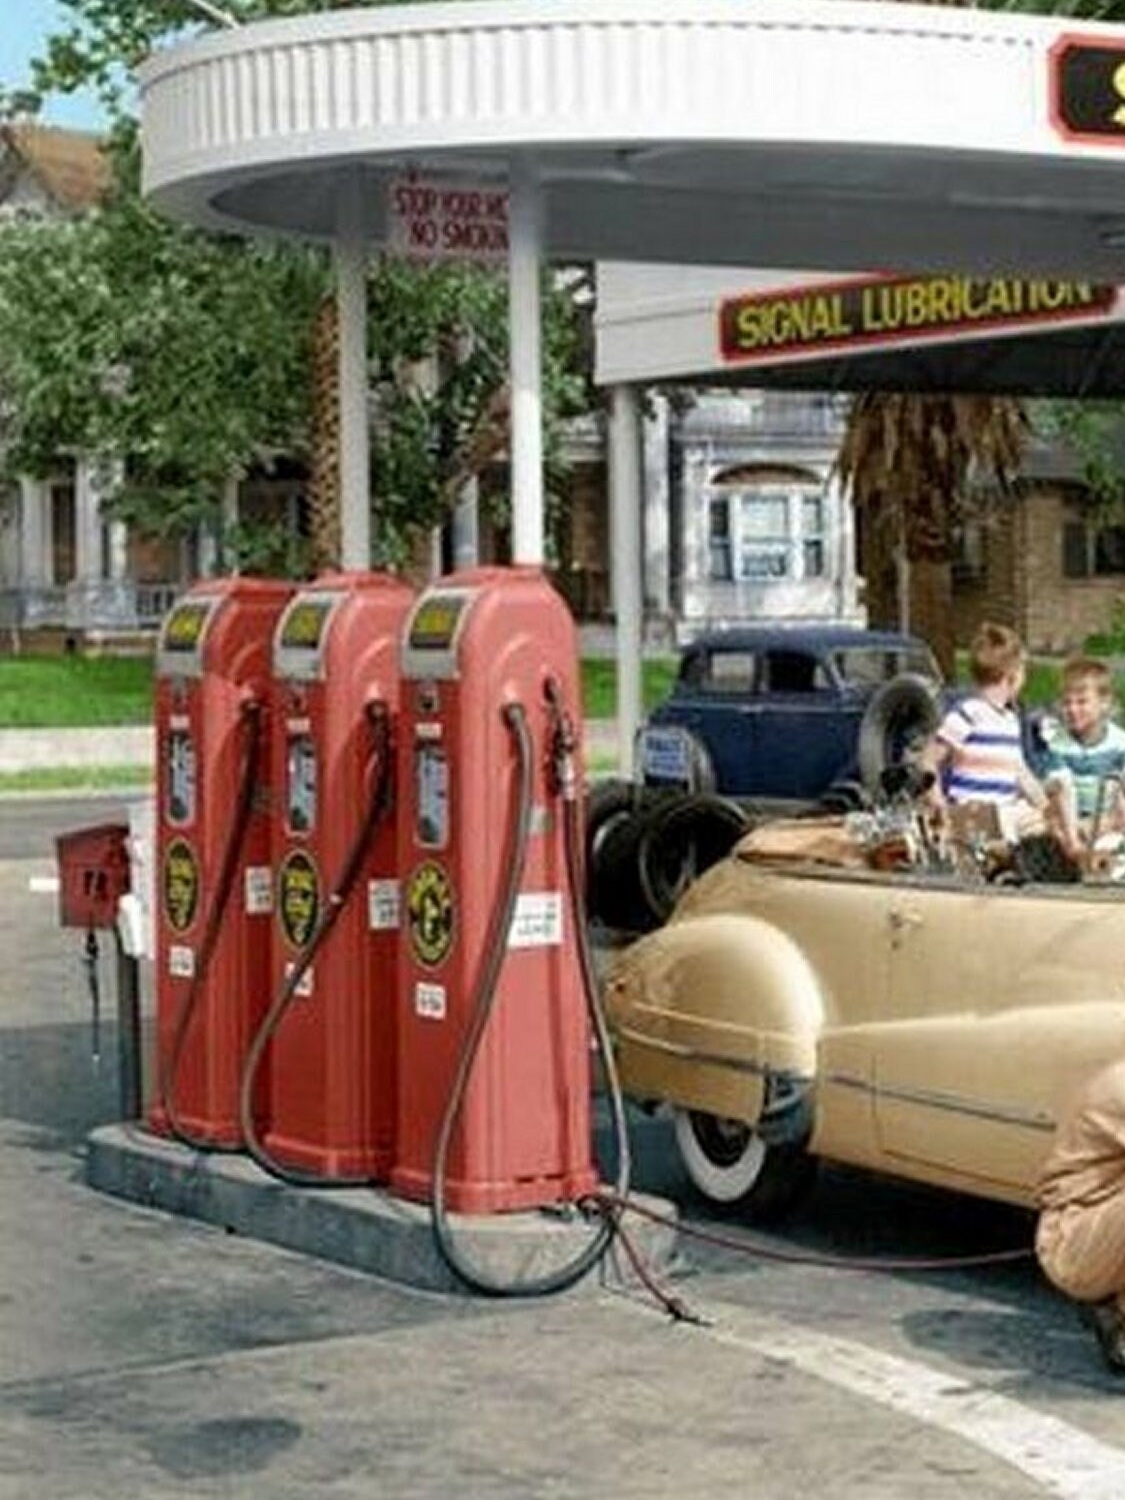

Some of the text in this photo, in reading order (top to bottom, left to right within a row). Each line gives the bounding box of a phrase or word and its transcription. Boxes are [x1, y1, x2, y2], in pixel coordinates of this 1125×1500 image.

[395, 186, 438, 217] STOP
[409, 219, 510, 251] NO SMOKIN
[736, 285, 851, 349] SIGNAL
